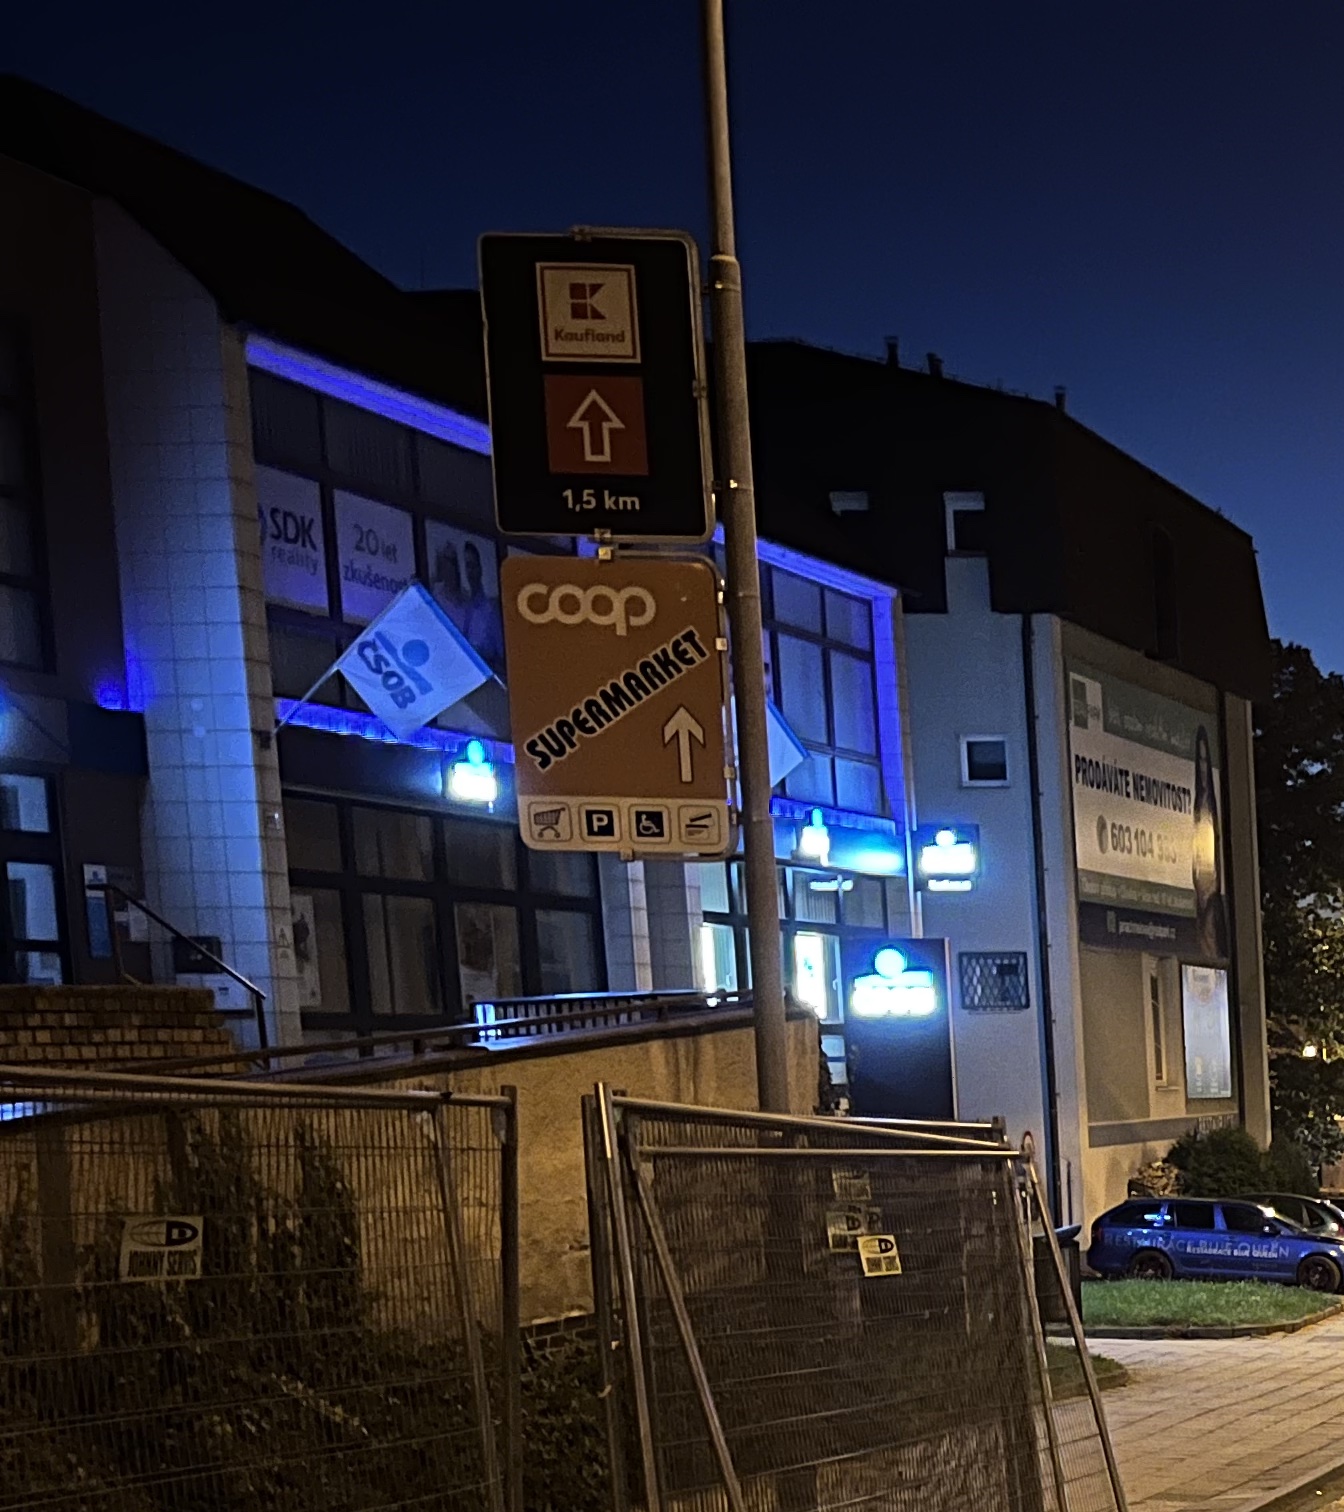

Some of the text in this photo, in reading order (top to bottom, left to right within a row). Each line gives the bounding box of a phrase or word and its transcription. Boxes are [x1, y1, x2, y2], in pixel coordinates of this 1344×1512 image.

[554, 328, 625, 343] Kaufland
[562, 488, 640, 512] 1,5 km
[269, 507, 317, 552] SDK
[353, 523, 379, 556] 20
[271, 546, 319, 576] reality
[517, 583, 657, 636] coop
[524, 627, 709, 771] SUPERMARKET
[1074, 754, 1131, 798] PRODÁVÁTE
[1111, 822, 1133, 855] 603
[1134, 828, 1154, 858] 104
